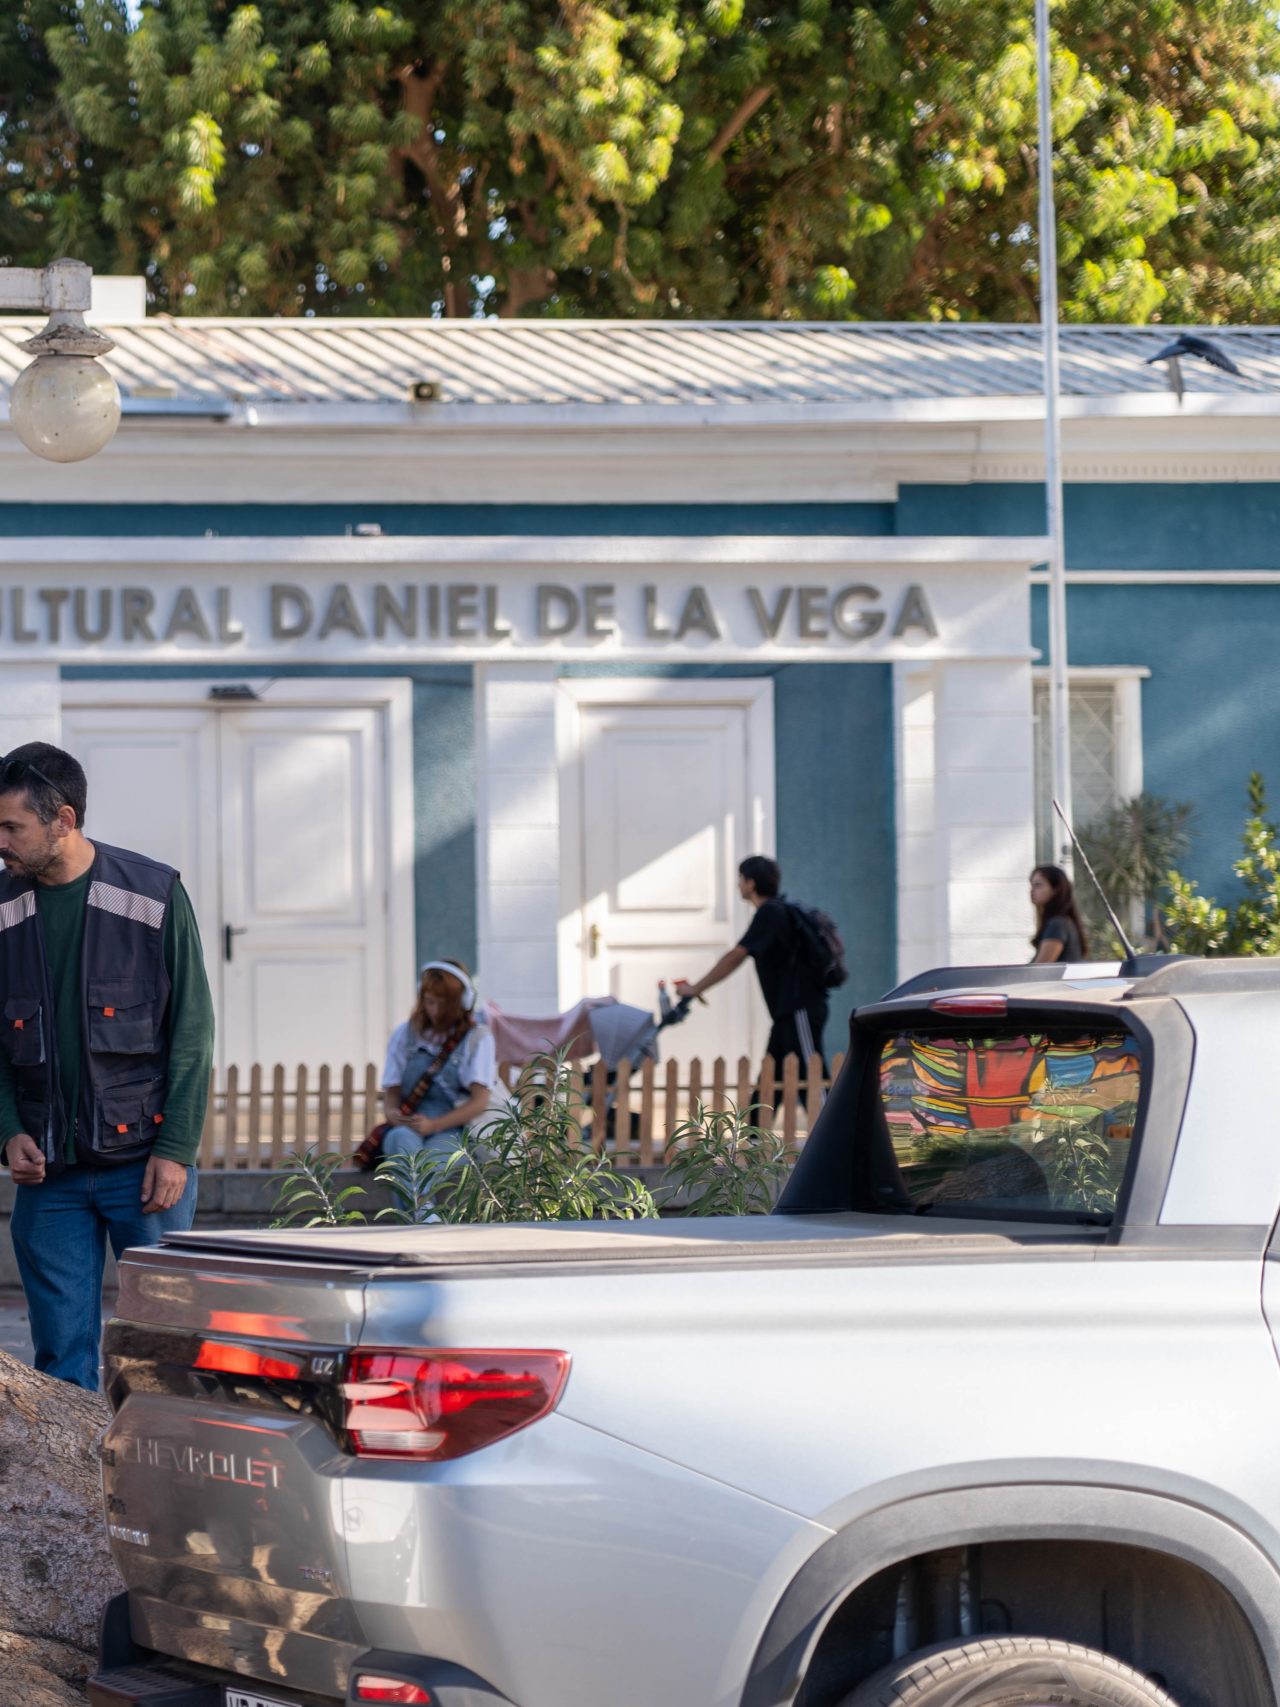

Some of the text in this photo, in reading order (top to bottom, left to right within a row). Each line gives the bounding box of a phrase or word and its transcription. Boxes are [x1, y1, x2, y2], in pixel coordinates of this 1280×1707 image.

[268, 583, 513, 641] DANIEL
[537, 583, 619, 641] DE
[644, 583, 723, 640] LA
[746, 583, 941, 641] VEGA
